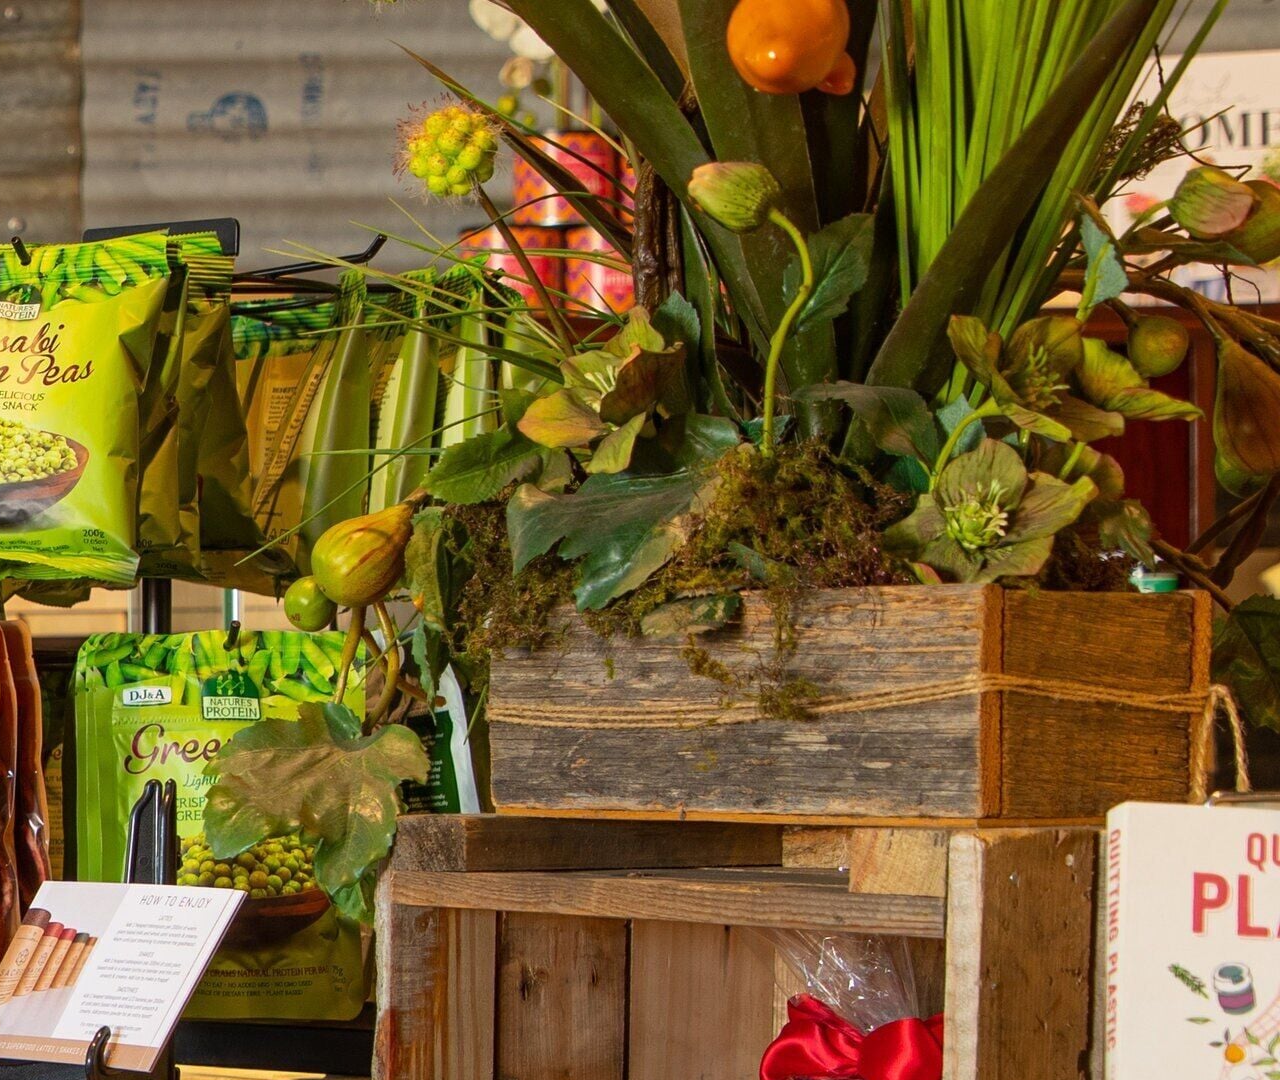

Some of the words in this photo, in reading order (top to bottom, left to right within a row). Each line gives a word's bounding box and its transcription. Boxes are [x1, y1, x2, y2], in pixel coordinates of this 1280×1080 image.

[17, 353, 95, 387] Peas
[2, 402, 38, 412] SNACK
[82, 529, 105, 539] 200g
[130, 689, 165, 701] DJ&A
[209, 698, 252, 706] NATURES
[206, 707, 258, 718] PROTEIN
[124, 723, 232, 775] Gree
[139, 895, 162, 906] HOW
[164, 896, 177, 907] TO
[178, 897, 213, 908] ENJOY
[1192, 872, 1280, 938] PL
[240, 968, 270, 977] NATURAL
[272, 967, 303, 977] PROTEIN
[305, 967, 319, 975] PER
[1106, 950, 1120, 1052] PLASTIC
